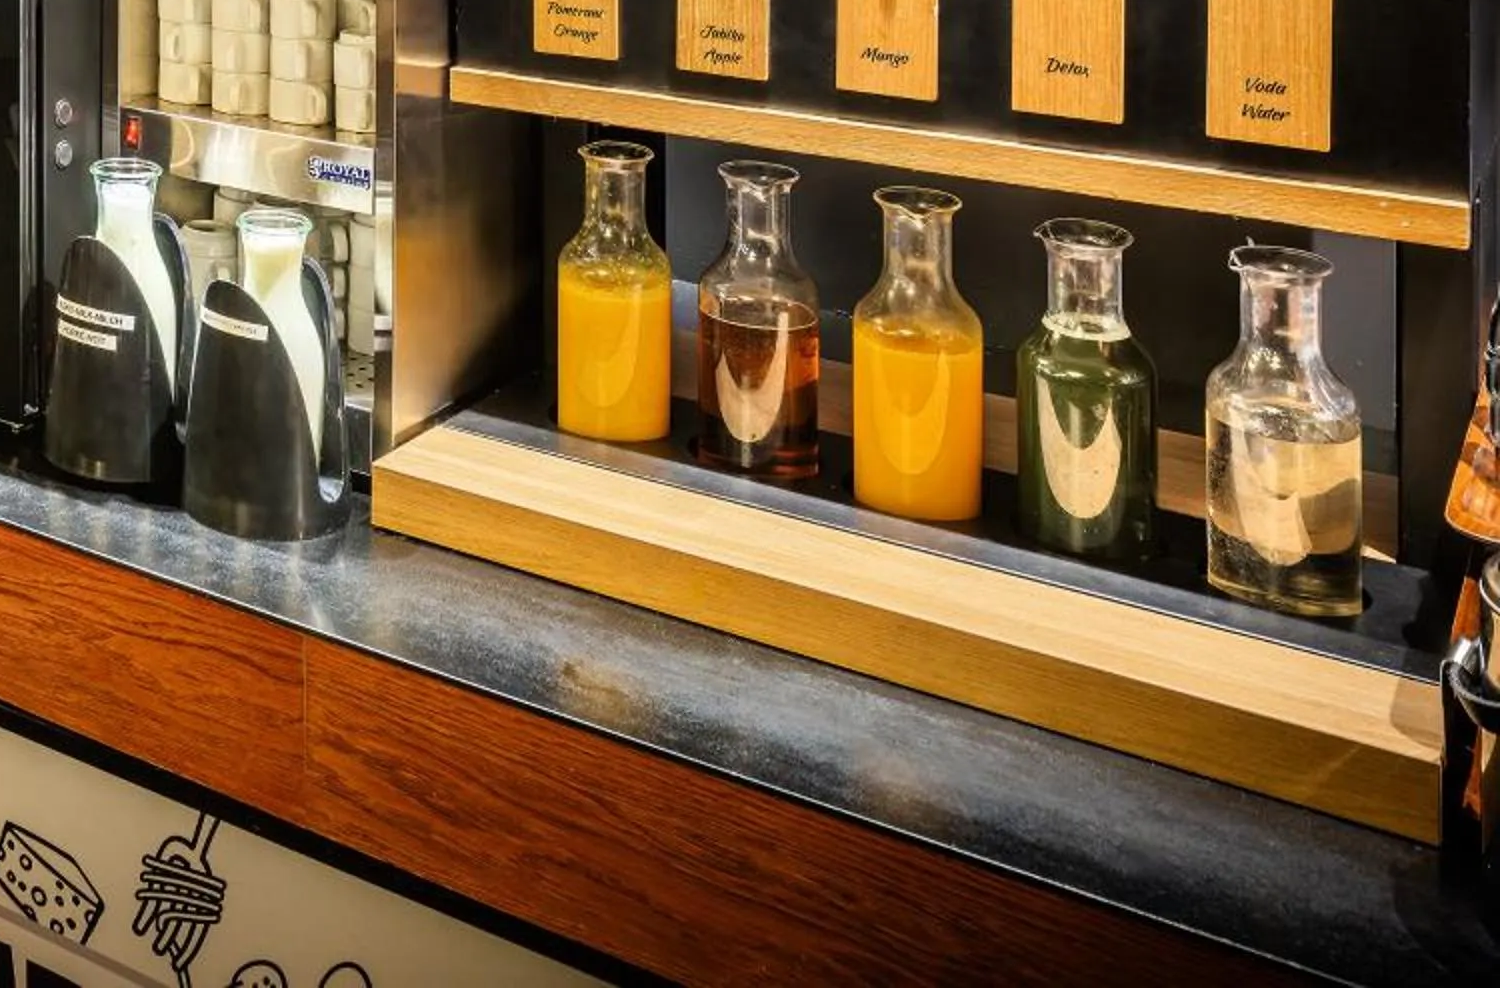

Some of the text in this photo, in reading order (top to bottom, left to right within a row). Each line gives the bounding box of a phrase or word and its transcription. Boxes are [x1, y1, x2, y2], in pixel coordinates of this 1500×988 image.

[860, 46, 910, 69] Mango
[1046, 56, 1090, 79] Detox
[1244, 77, 1288, 95] Voda
[1241, 103, 1291, 122] Water
